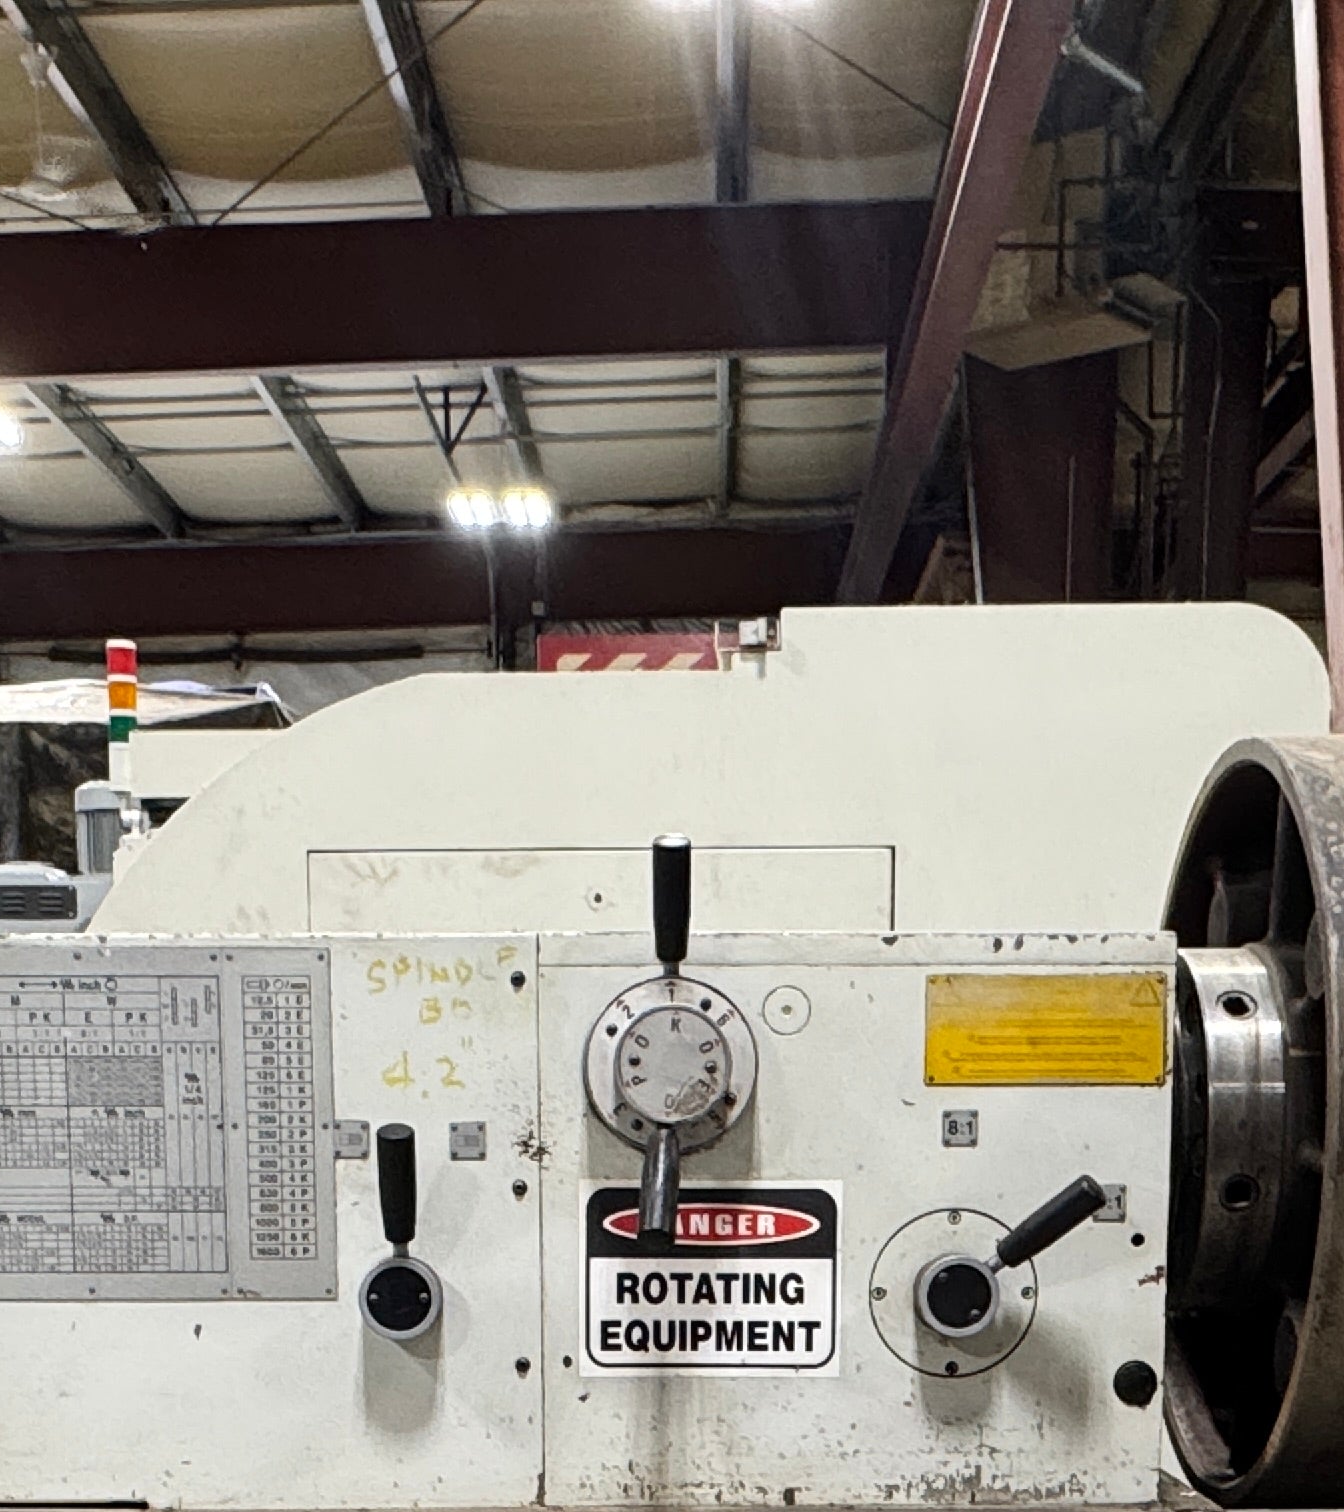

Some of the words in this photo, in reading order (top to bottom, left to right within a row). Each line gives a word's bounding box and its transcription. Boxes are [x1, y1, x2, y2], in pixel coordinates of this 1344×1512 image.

[622, 1004, 635, 1019] 2
[671, 1018, 681, 1033] K
[948, 1120, 974, 1135] 8:1
[675, 1213, 776, 1236] NGER
[616, 1272, 805, 1305] ROTATING
[600, 1319, 822, 1353] EQUIPMENT
